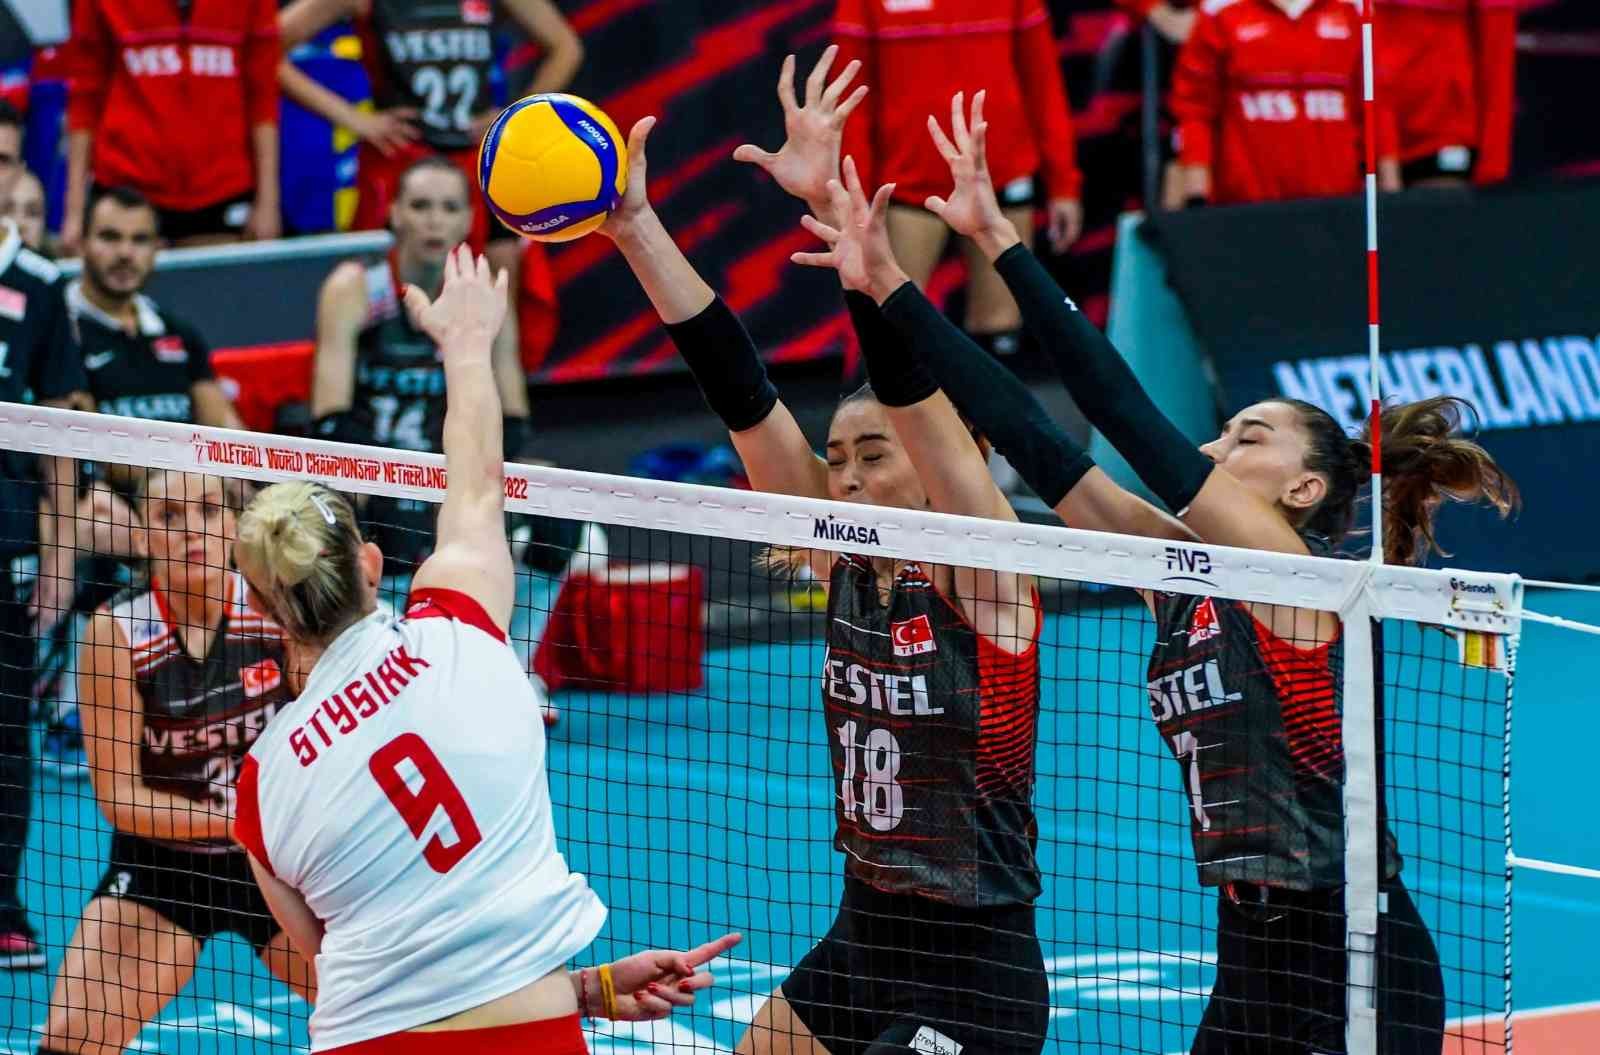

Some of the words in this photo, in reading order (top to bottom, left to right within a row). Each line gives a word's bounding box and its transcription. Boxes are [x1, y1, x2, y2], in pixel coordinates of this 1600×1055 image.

[412, 65, 479, 131] 22
[1273, 335, 1600, 438] NETHERLAND
[206, 440, 263, 467] VOLLEYBALL
[265, 447, 303, 472] WORLD
[305, 453, 380, 482] CHAMPIONSHIP
[383, 462, 448, 489] NETHERLAND
[813, 513, 881, 546] MIKASA
[1165, 547, 1212, 574] FIVB
[1459, 580, 1496, 593] Senoh
[289, 645, 432, 767] STYSIAK
[1147, 658, 1243, 723] STEL
[368, 732, 482, 874] 9
[838, 720, 904, 832] 18
